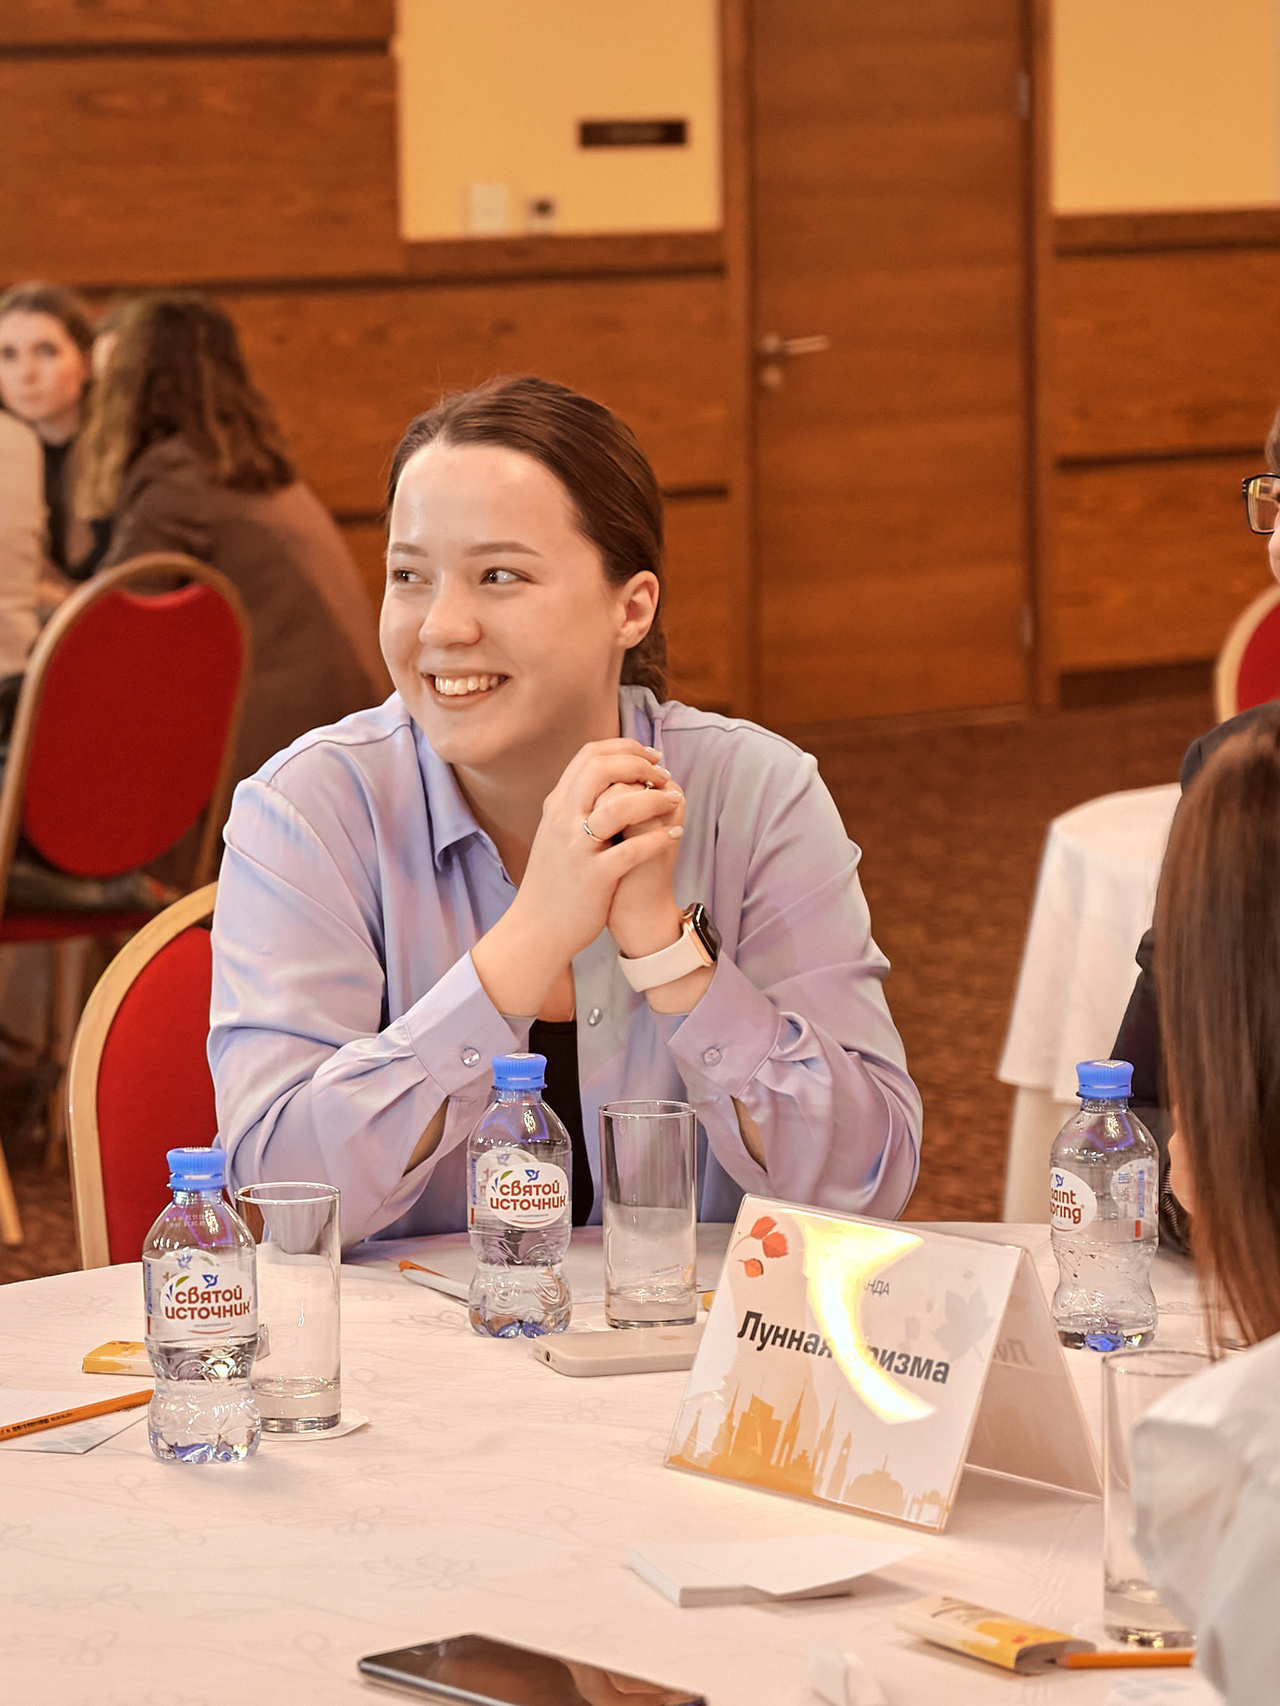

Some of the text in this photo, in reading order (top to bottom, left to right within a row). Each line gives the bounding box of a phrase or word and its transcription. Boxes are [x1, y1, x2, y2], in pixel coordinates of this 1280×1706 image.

[1051, 1202, 1082, 1225] pring
[737, 1310, 833, 1359] Лунная
[865, 1344, 951, 1384] ризма
